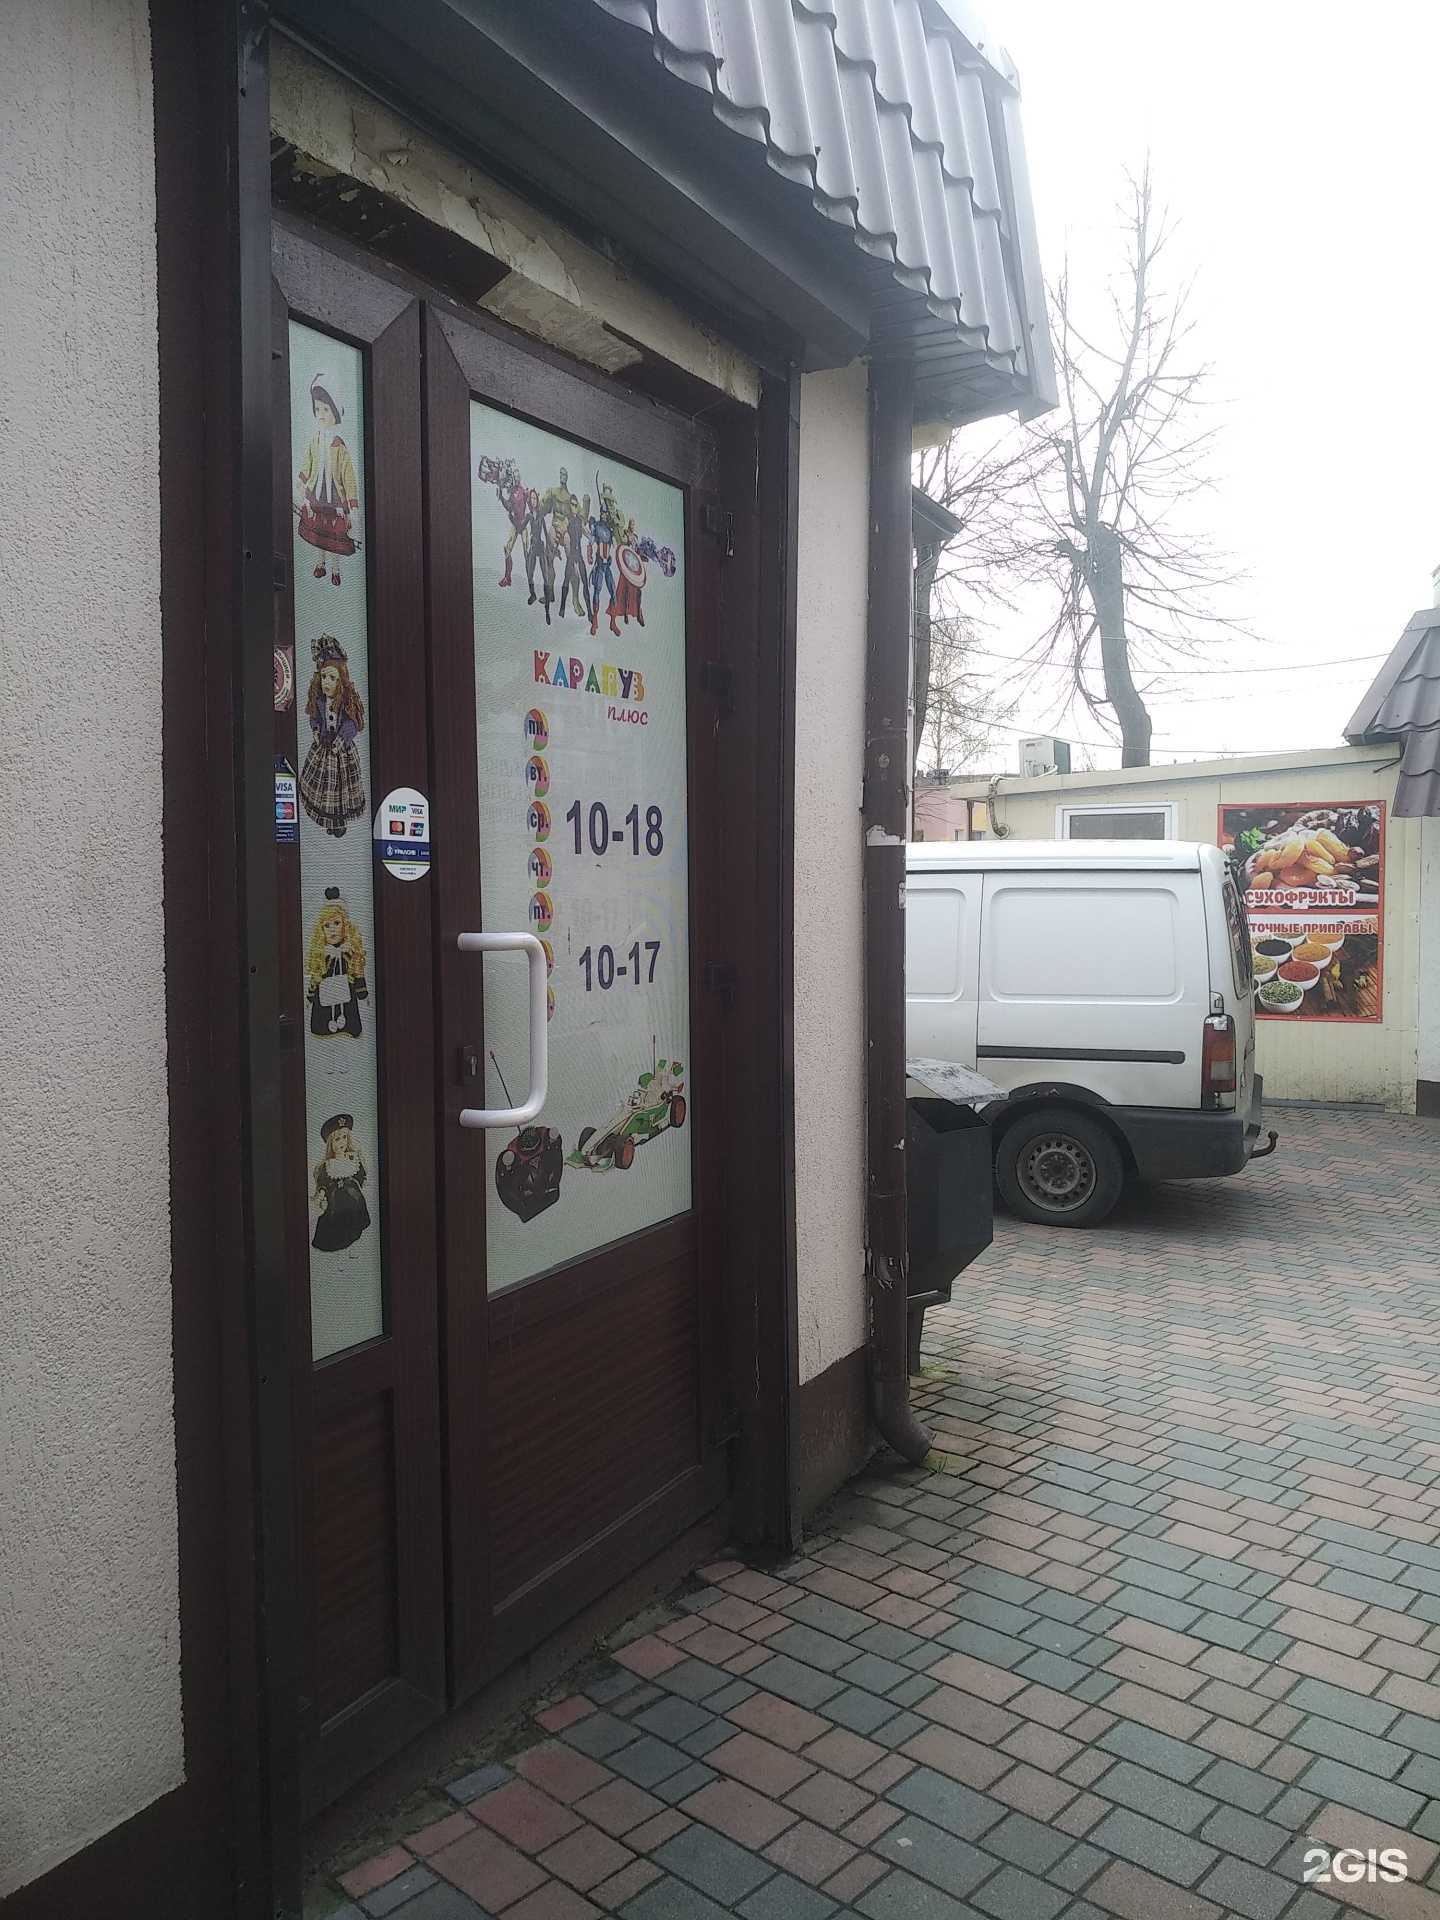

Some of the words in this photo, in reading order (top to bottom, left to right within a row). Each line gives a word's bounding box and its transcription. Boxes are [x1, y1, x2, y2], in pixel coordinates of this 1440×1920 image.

[533, 650, 646, 703] КАРАПУЗ
[607, 704, 649, 726] плюс
[528, 719, 548, 736] пн.
[530, 766, 548, 782] вт.
[411, 807, 424, 815] VISA
[530, 812, 549, 832] ср.
[566, 800, 664, 857] 10-18
[531, 863, 549, 877] чт.
[1245, 890, 1354, 905] СУХОФРУКТЫ
[533, 905, 551, 920] пт.
[1249, 923, 1300, 933] ТОЧНЫЕ
[1302, 923, 1372, 934] ПРИПРАВЫ
[578, 941, 662, 992] 10-17
